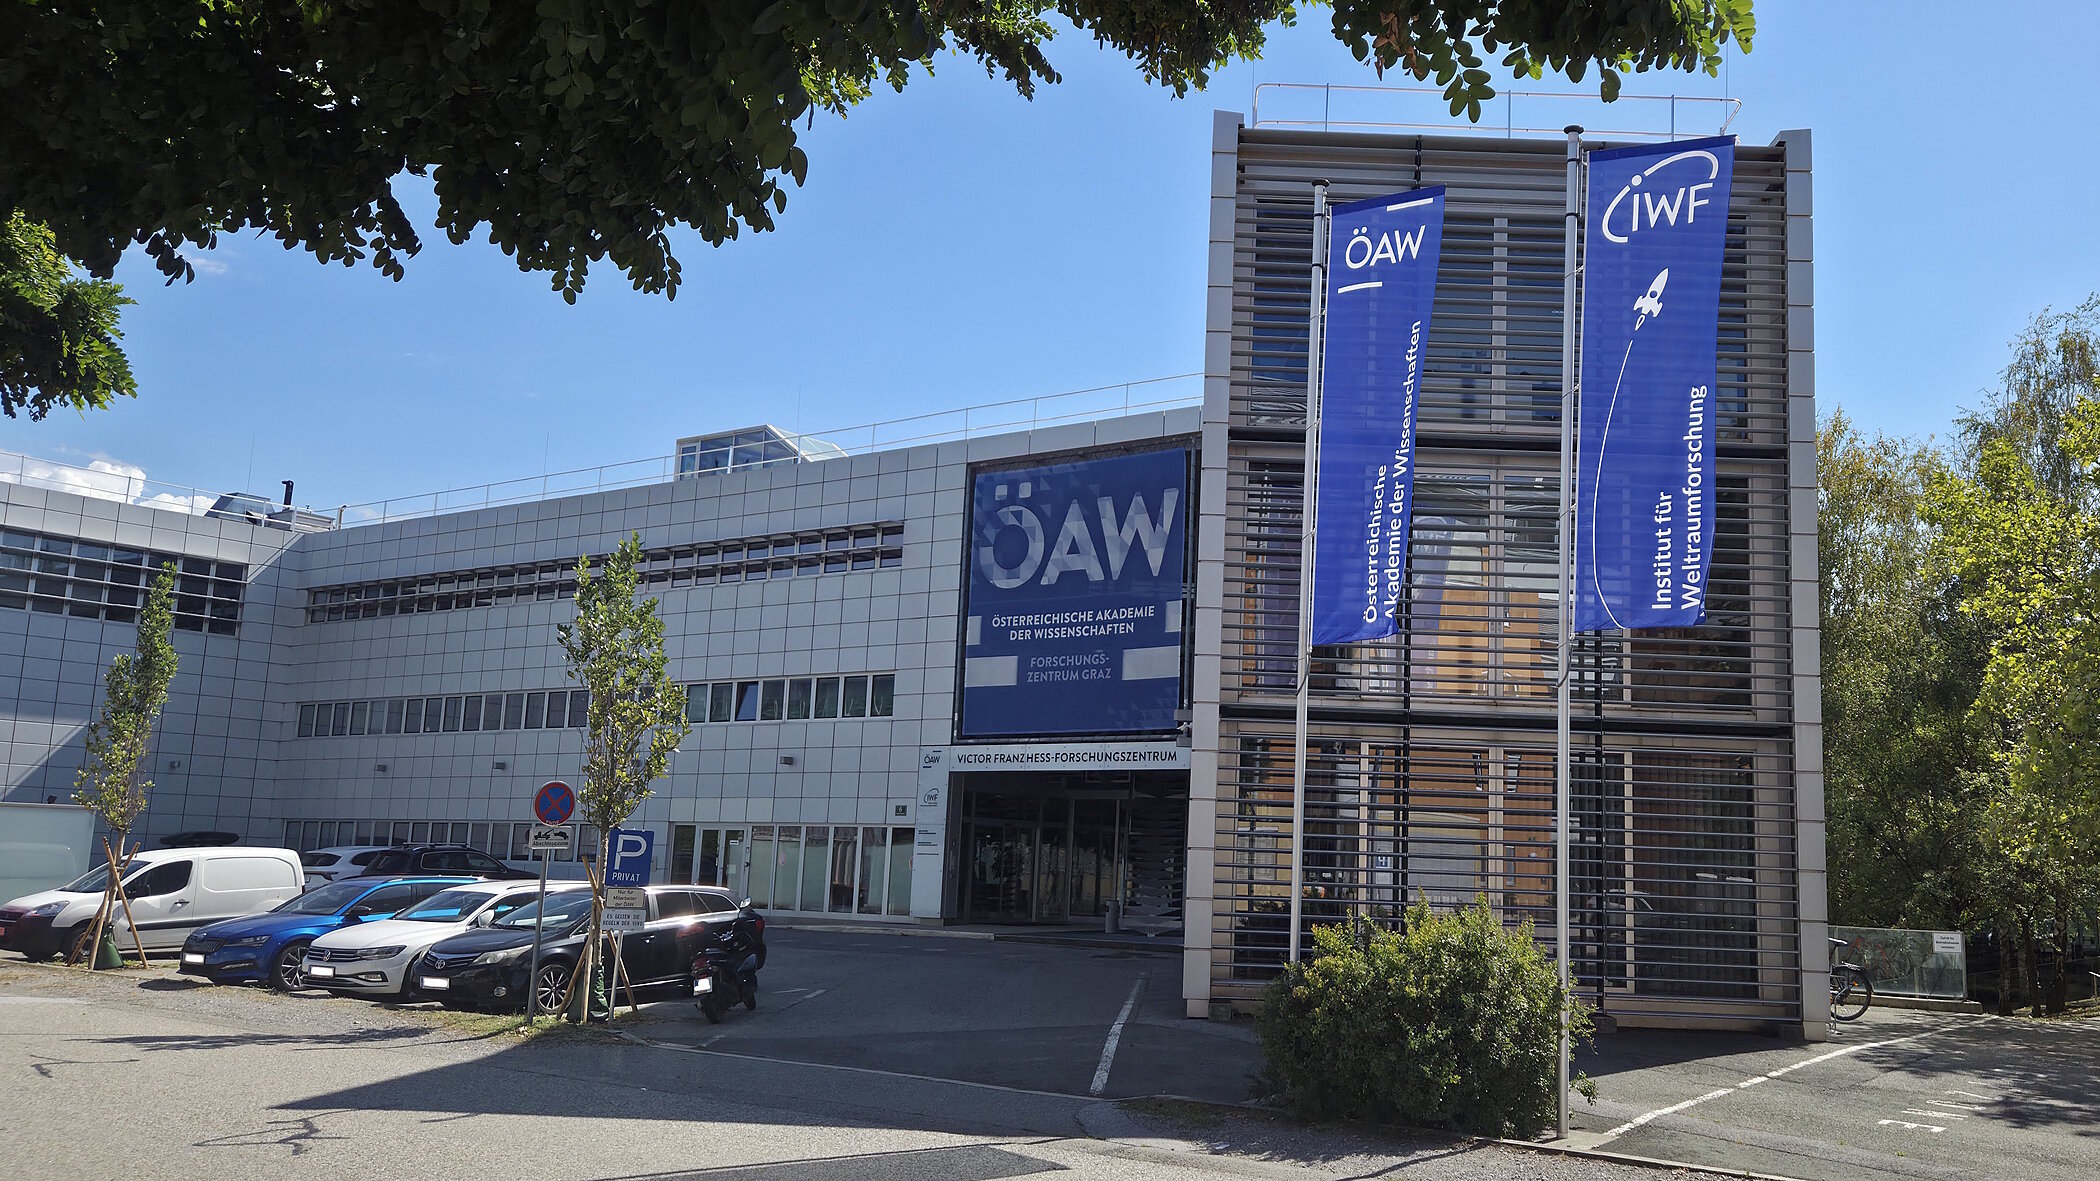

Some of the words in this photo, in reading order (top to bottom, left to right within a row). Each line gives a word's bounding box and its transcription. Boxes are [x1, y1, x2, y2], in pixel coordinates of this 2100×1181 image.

[1345, 224, 1426, 270] ÖAW
[1392, 319, 1422, 480] Wissenschaften
[1388, 483, 1406, 516] der
[1654, 491, 1673, 523] für
[1680, 385, 1708, 610] Weltraumforschung
[979, 481, 1180, 589] ÖAW
[1362, 464, 1388, 624] Österreichische
[1384, 521, 1402, 620] Akademie
[1651, 529, 1673, 610] Institut
[992, 610, 1094, 628] ÖSTERREICHISCHE
[1095, 605, 1156, 622] AKADEMIE
[1009, 628, 1032, 641] DER
[1034, 622, 1135, 640] WISSENSCHAFTEN
[1027, 669, 1080, 683] ZENTRUM
[1081, 667, 1112, 681] GRAZ
[1030, 653, 1110, 668] FORSCHUNGS-
[923, 754, 941, 764] ÖAW
[957, 752, 992, 764] VICTOR
[532, 840, 569, 848] Abschleppzone
[613, 834, 647, 870] P
[612, 872, 641, 882] PRIVAT
